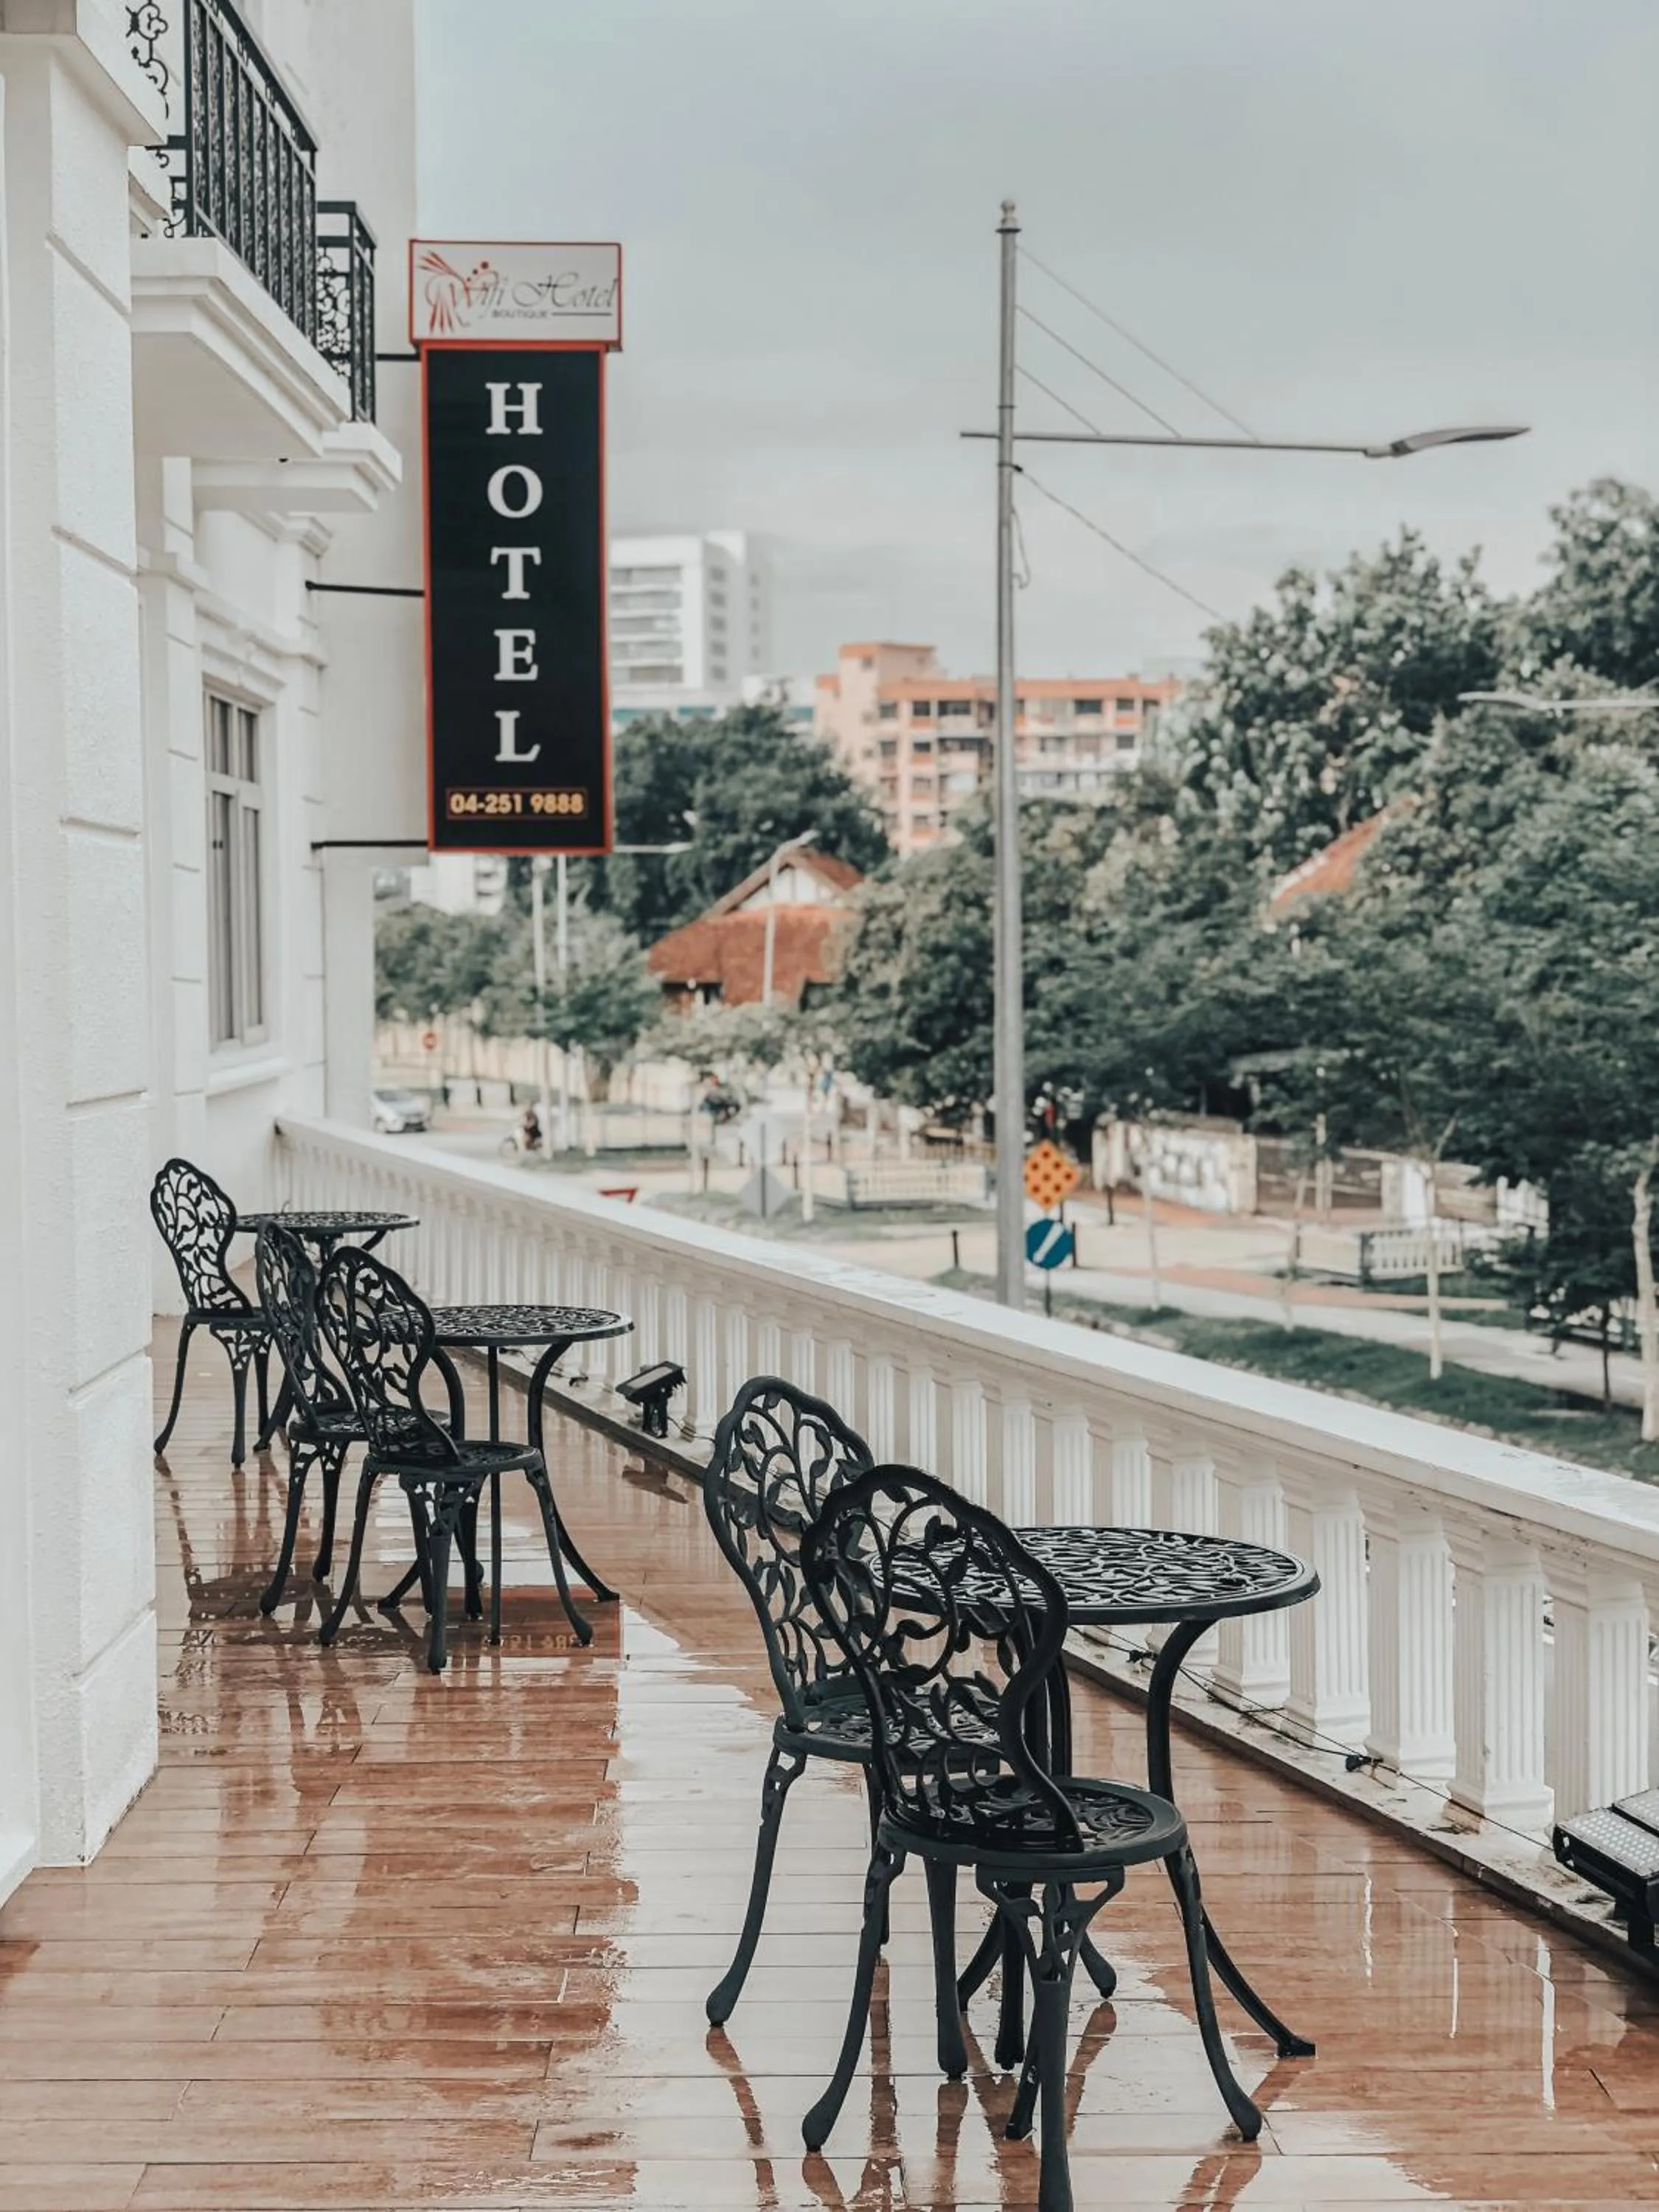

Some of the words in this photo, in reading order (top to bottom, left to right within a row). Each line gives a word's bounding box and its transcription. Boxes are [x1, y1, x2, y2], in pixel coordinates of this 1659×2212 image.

[512, 271, 619, 307] Hotel
[491, 310, 547, 319] BOUTIQUE
[485, 382, 543, 762] HOTEL
[451, 793, 523, 814] 04-251
[530, 793, 584, 814] 9888
